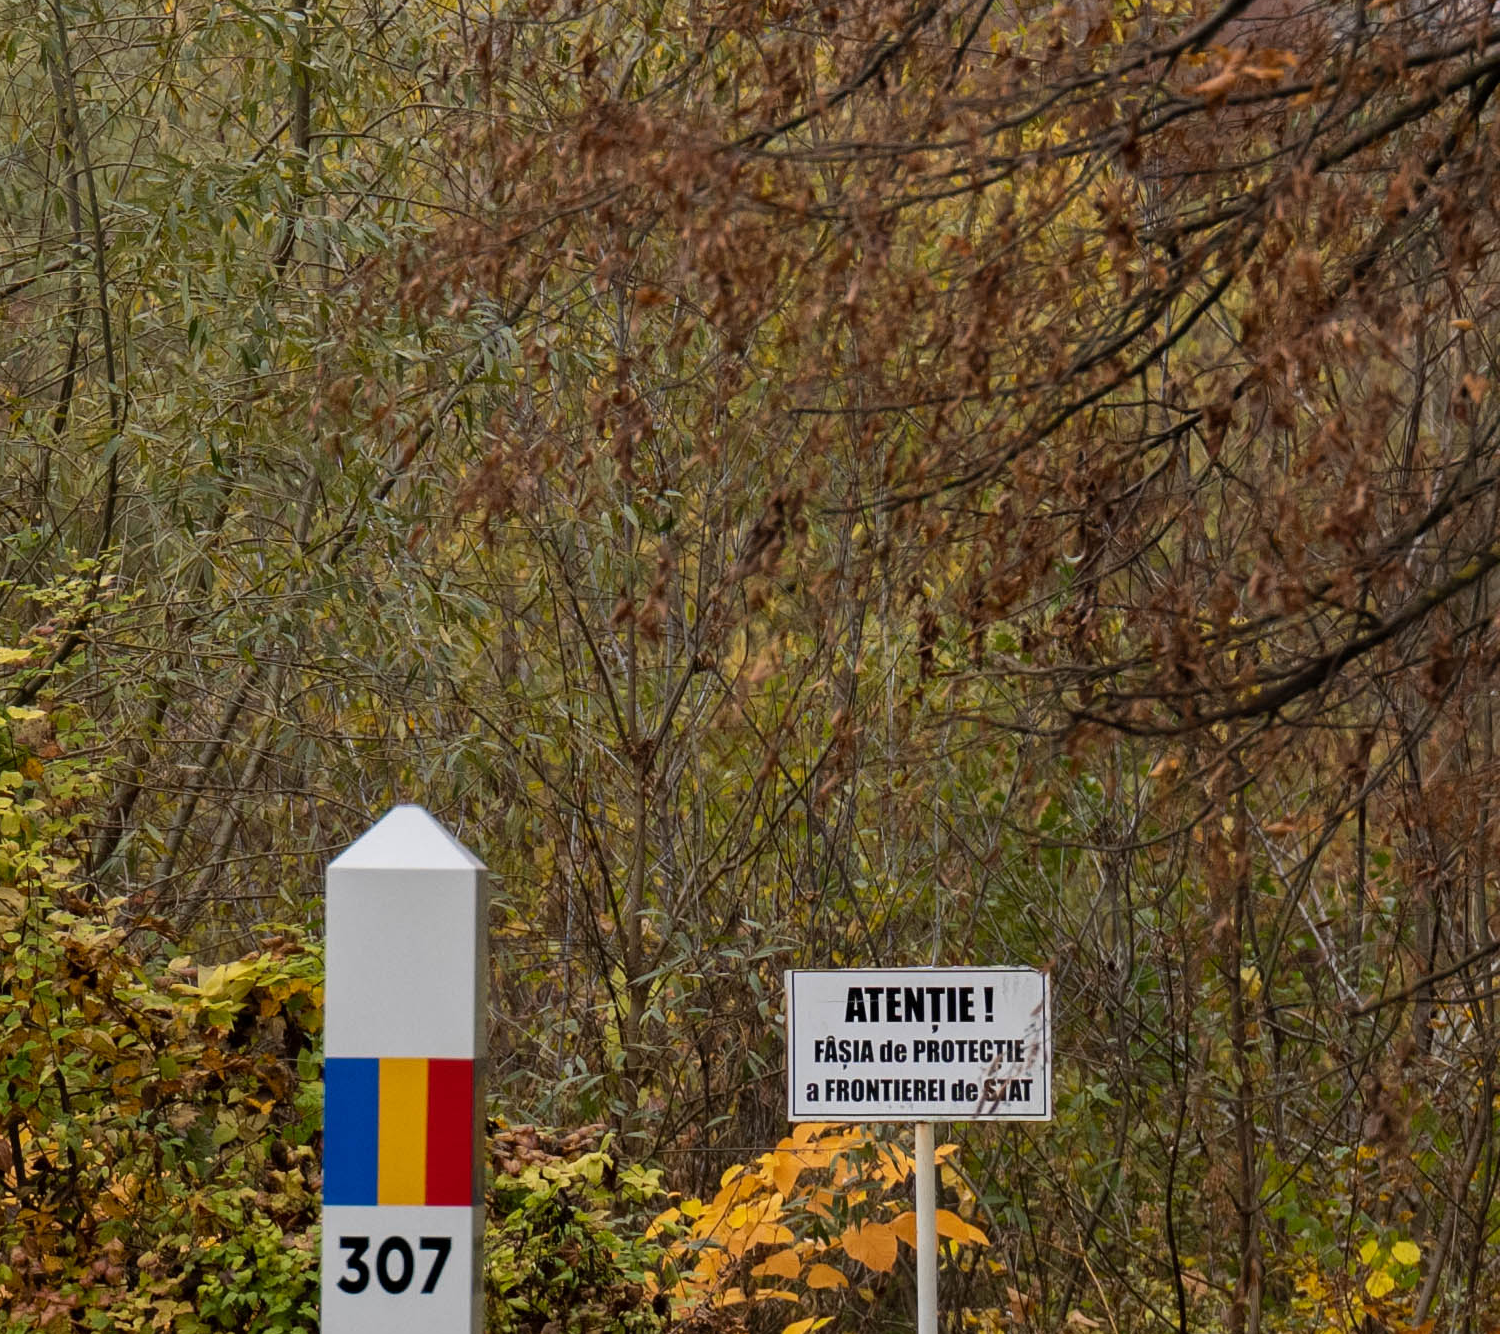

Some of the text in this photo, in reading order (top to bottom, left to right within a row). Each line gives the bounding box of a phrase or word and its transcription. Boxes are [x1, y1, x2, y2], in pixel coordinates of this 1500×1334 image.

[844, 986, 976, 1034] ATENȚIE
[813, 1035, 875, 1071] FÂȘIA
[879, 1039, 908, 1063] de
[806, 1078, 1034, 1102] a FRONTIEREI de STAT
[336, 1235, 453, 1295] 307
